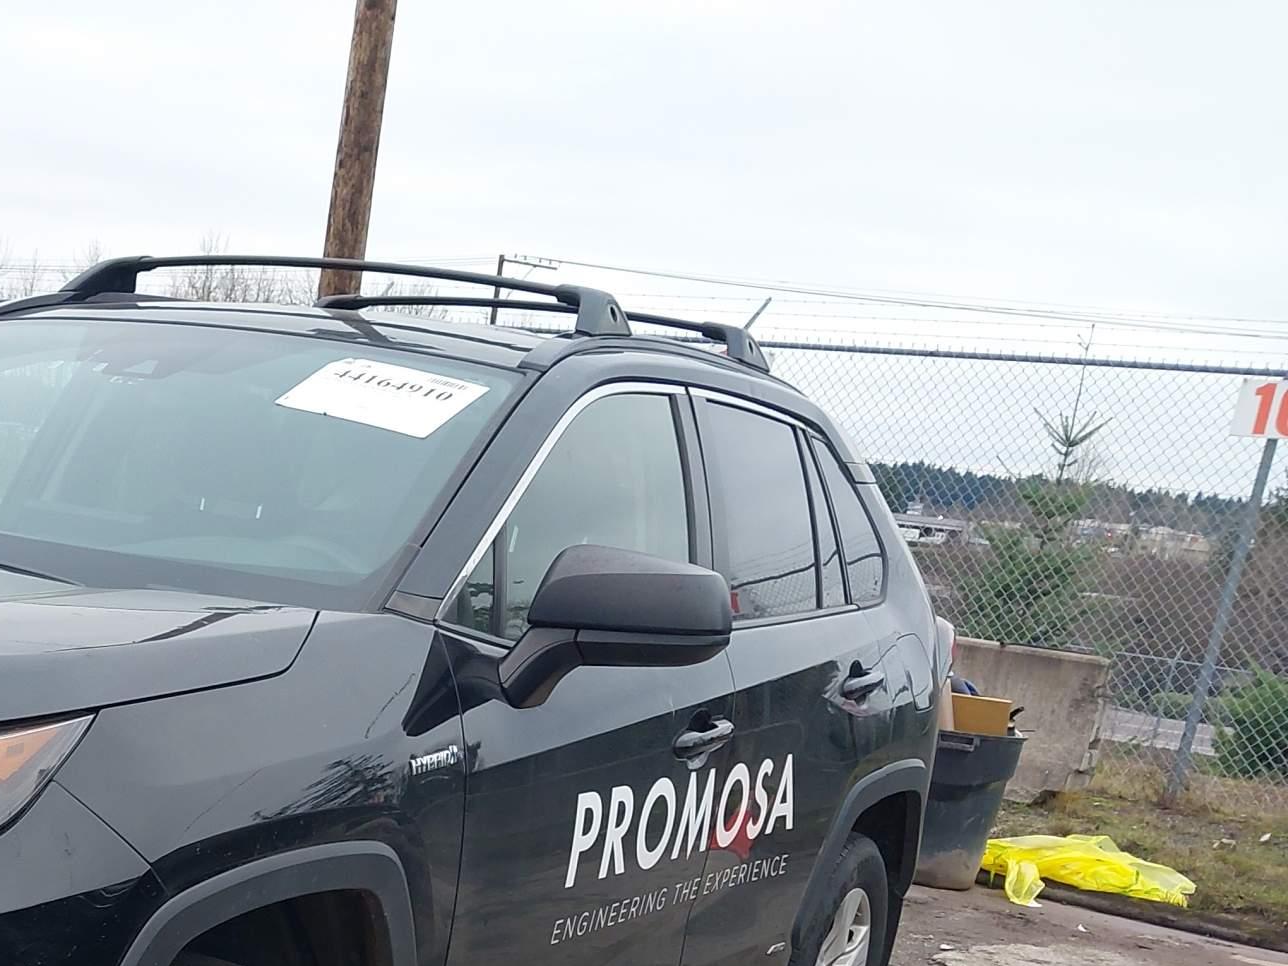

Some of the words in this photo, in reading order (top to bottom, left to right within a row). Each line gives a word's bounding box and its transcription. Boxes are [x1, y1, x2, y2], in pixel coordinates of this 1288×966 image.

[333, 368, 454, 402] 44164910
[564, 753, 794, 889] PROMOSA
[550, 887, 668, 945] ENGINEERING
[672, 877, 701, 905] THE
[703, 853, 790, 896] EXPERIENCE
